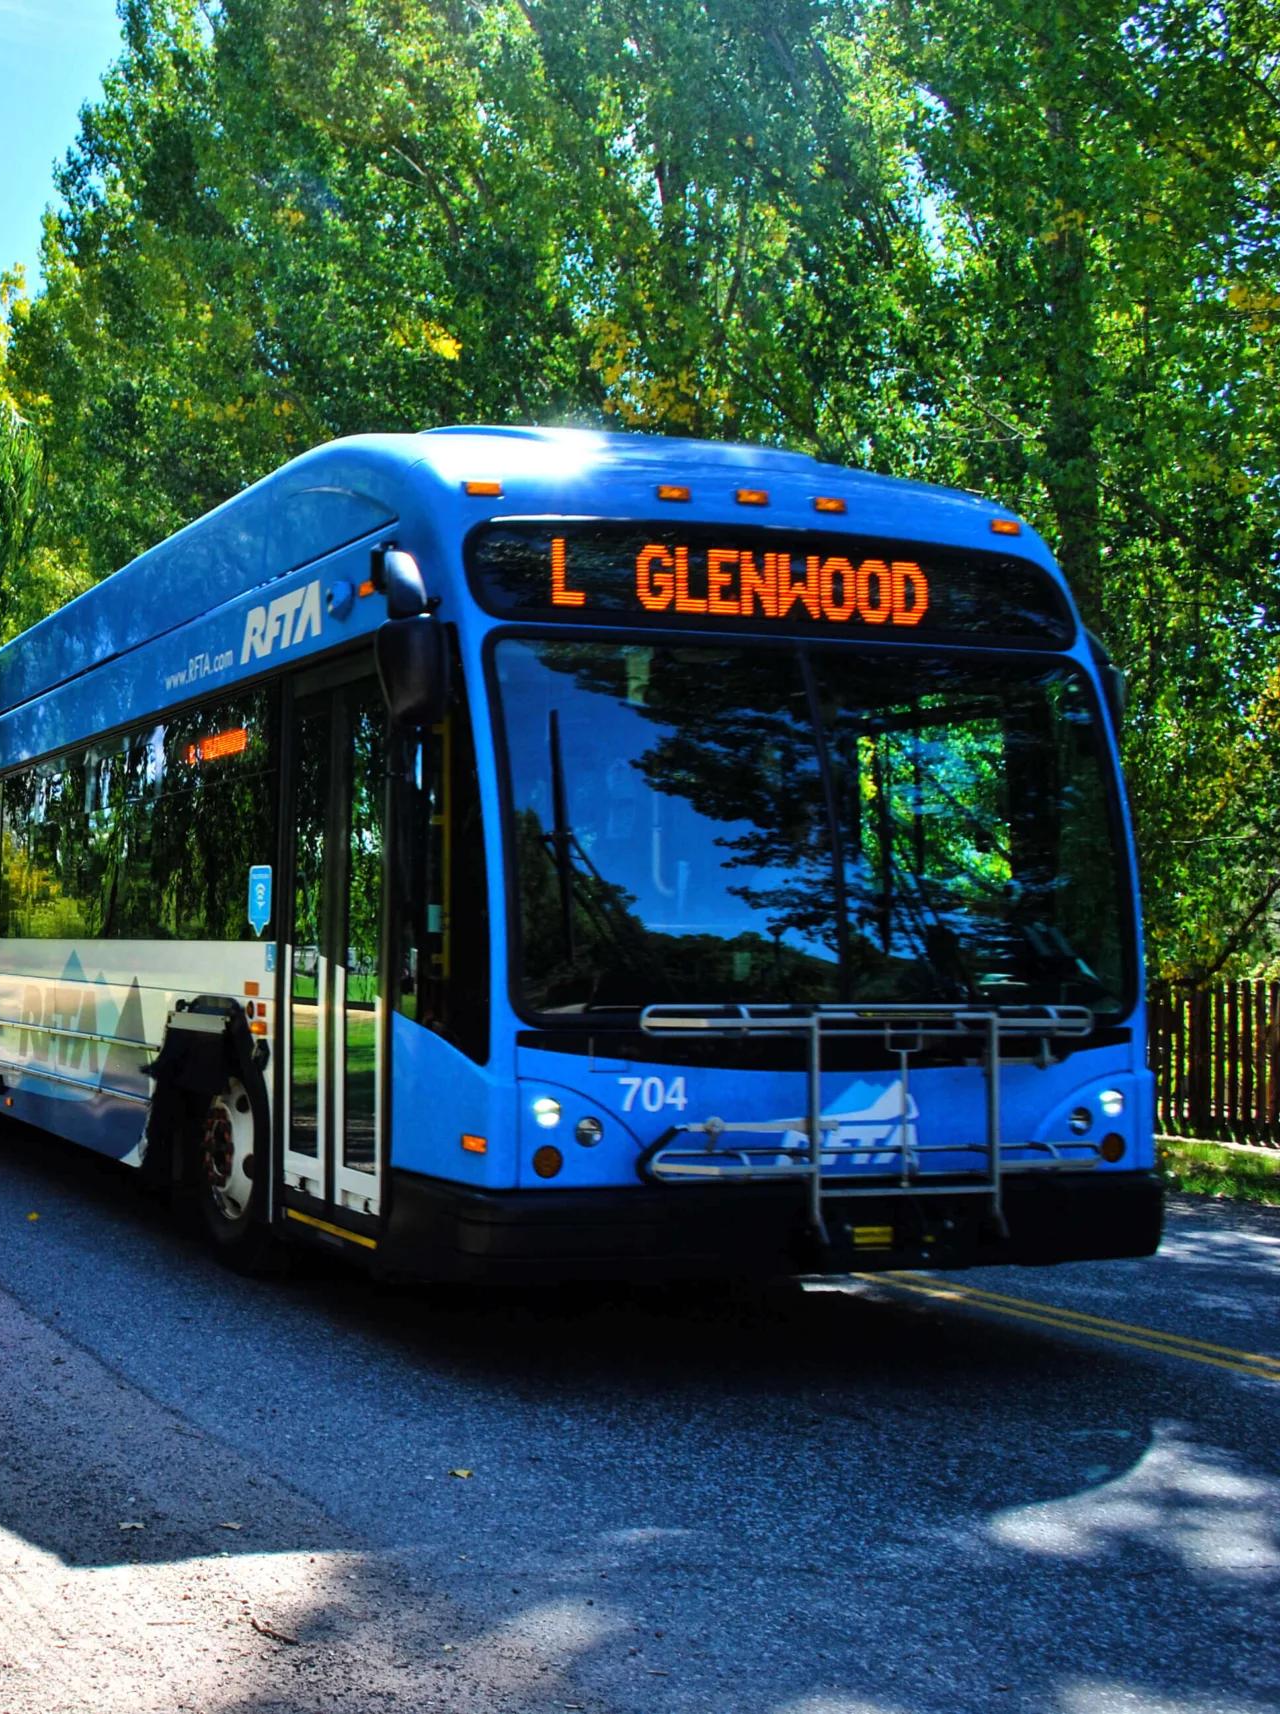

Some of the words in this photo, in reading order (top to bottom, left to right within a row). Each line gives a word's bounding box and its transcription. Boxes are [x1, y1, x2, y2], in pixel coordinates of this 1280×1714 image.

[240, 579, 322, 665] RFTA
[551, 538, 585, 606] L
[636, 544, 929, 626] GLENWOOD
[165, 649, 234, 691] www.RFTA.com
[18, 984, 99, 1074] RFTA
[617, 1076, 689, 1112] 704
